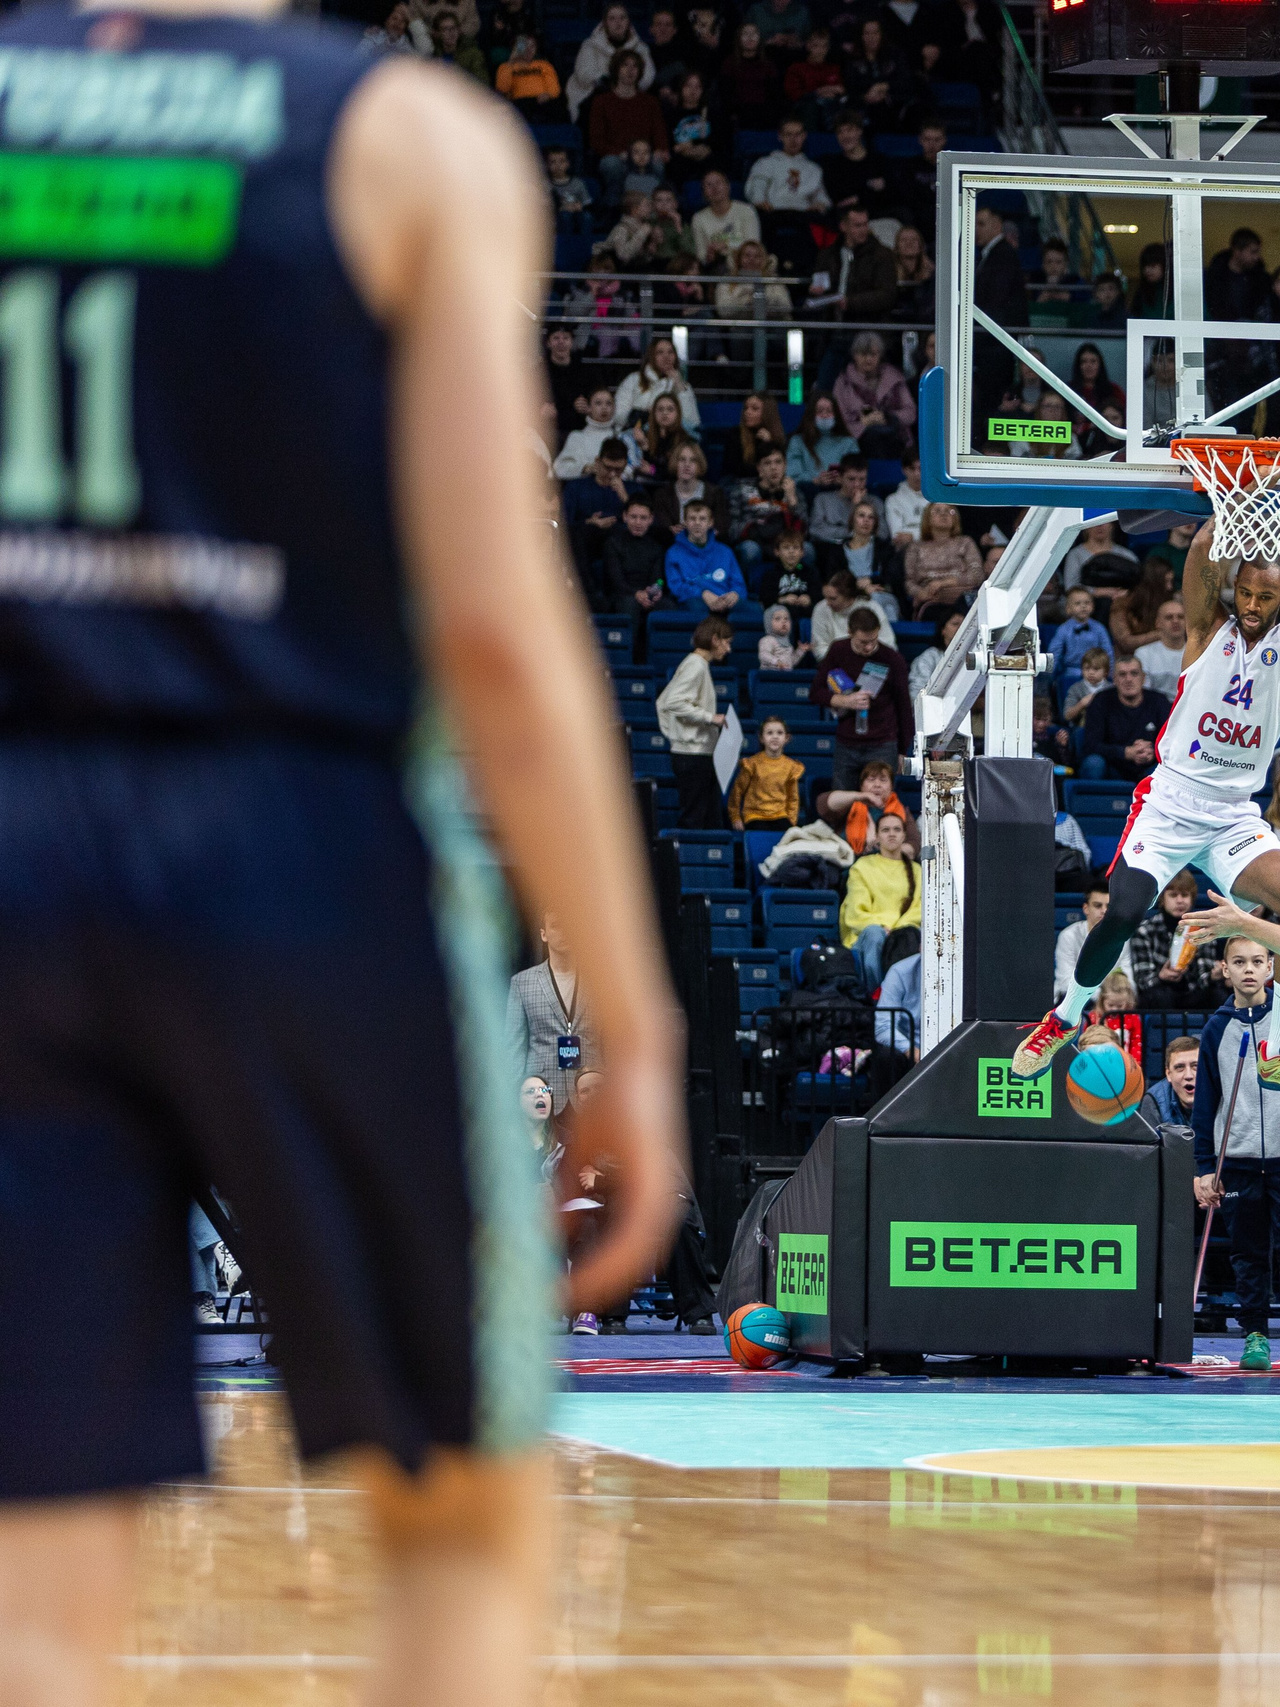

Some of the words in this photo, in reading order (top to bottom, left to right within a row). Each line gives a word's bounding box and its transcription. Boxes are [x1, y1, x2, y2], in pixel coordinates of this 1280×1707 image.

[1222, 674, 1254, 711] 24
[1198, 712, 1262, 749] CSKA
[1200, 751, 1256, 771] Rostelecom
